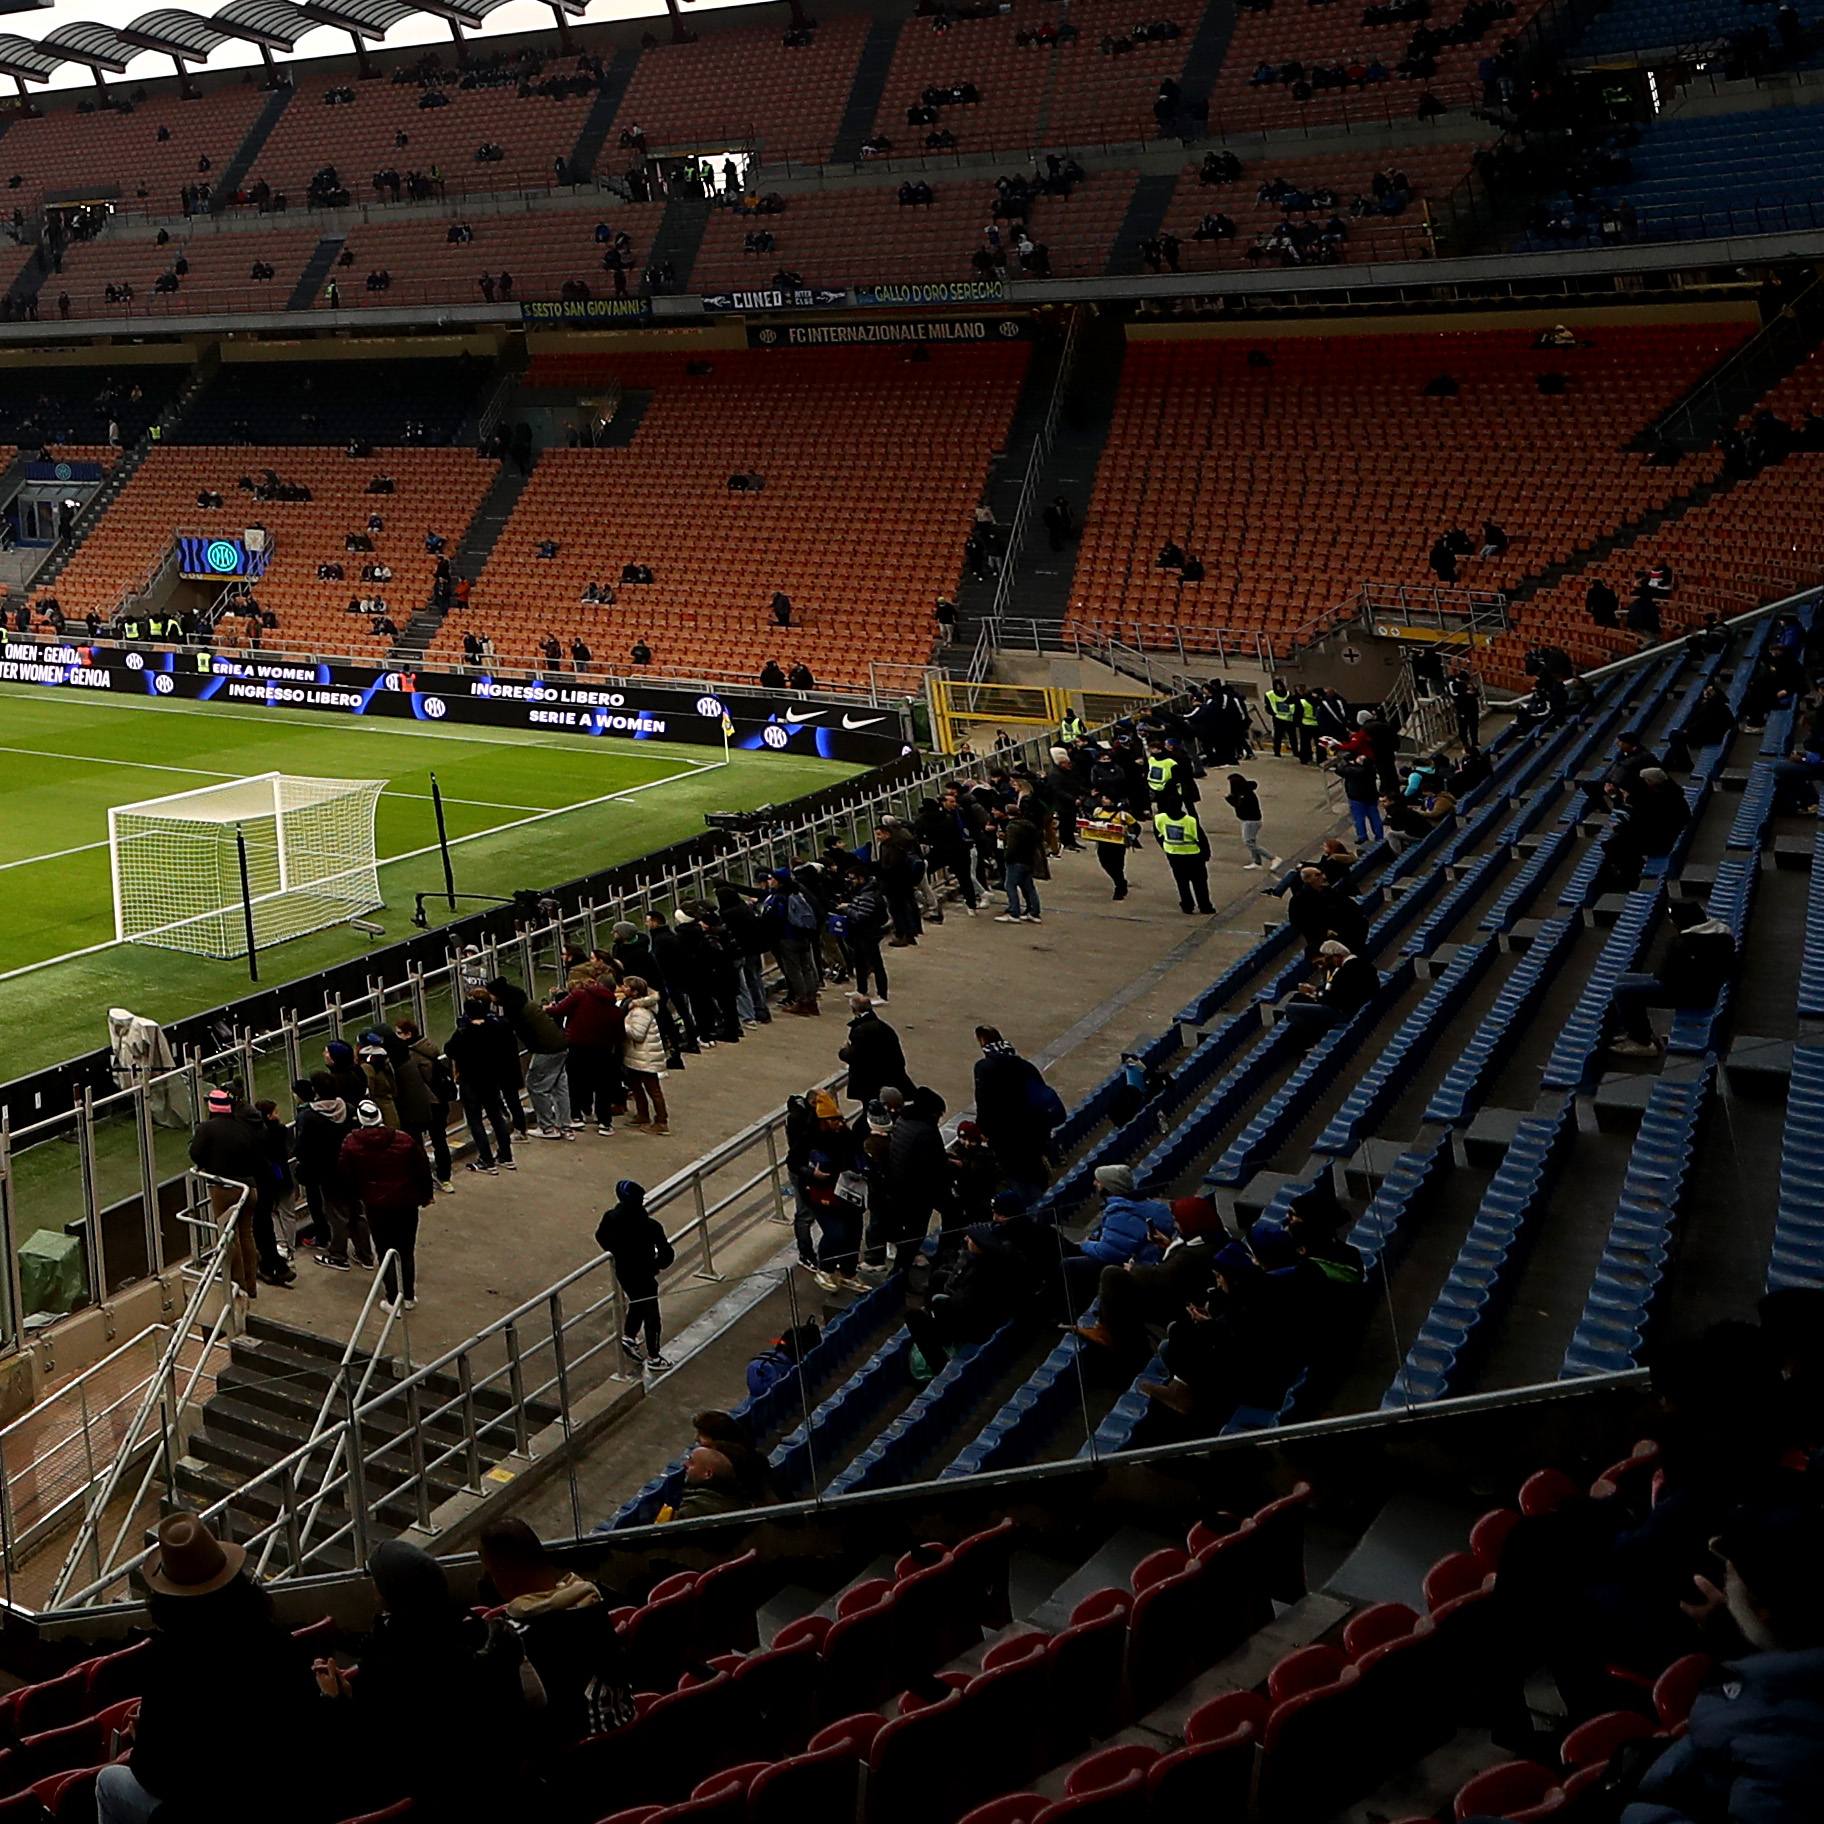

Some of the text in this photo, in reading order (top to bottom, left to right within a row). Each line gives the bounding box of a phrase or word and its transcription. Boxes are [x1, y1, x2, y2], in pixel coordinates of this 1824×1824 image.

[732, 291, 783, 309] CUNEO
[874, 280, 1003, 304] GALLO D'ORO SEREGNO
[532, 299, 640, 318] SESTO SAN GIOVANNI
[789, 322, 986, 344] FC INTERNAZIONALE MILANO
[44, 647, 82, 665] GENOA
[19, 662, 64, 683] WOMEN
[70, 667, 111, 688] GENOA
[212, 663, 315, 681] ERIE A WOMEN
[229, 683, 362, 708] INGRESSO LIBERO
[471, 682, 625, 707] INGRESSO LIBERO
[529, 709, 665, 733] SERIE A WOMEN
